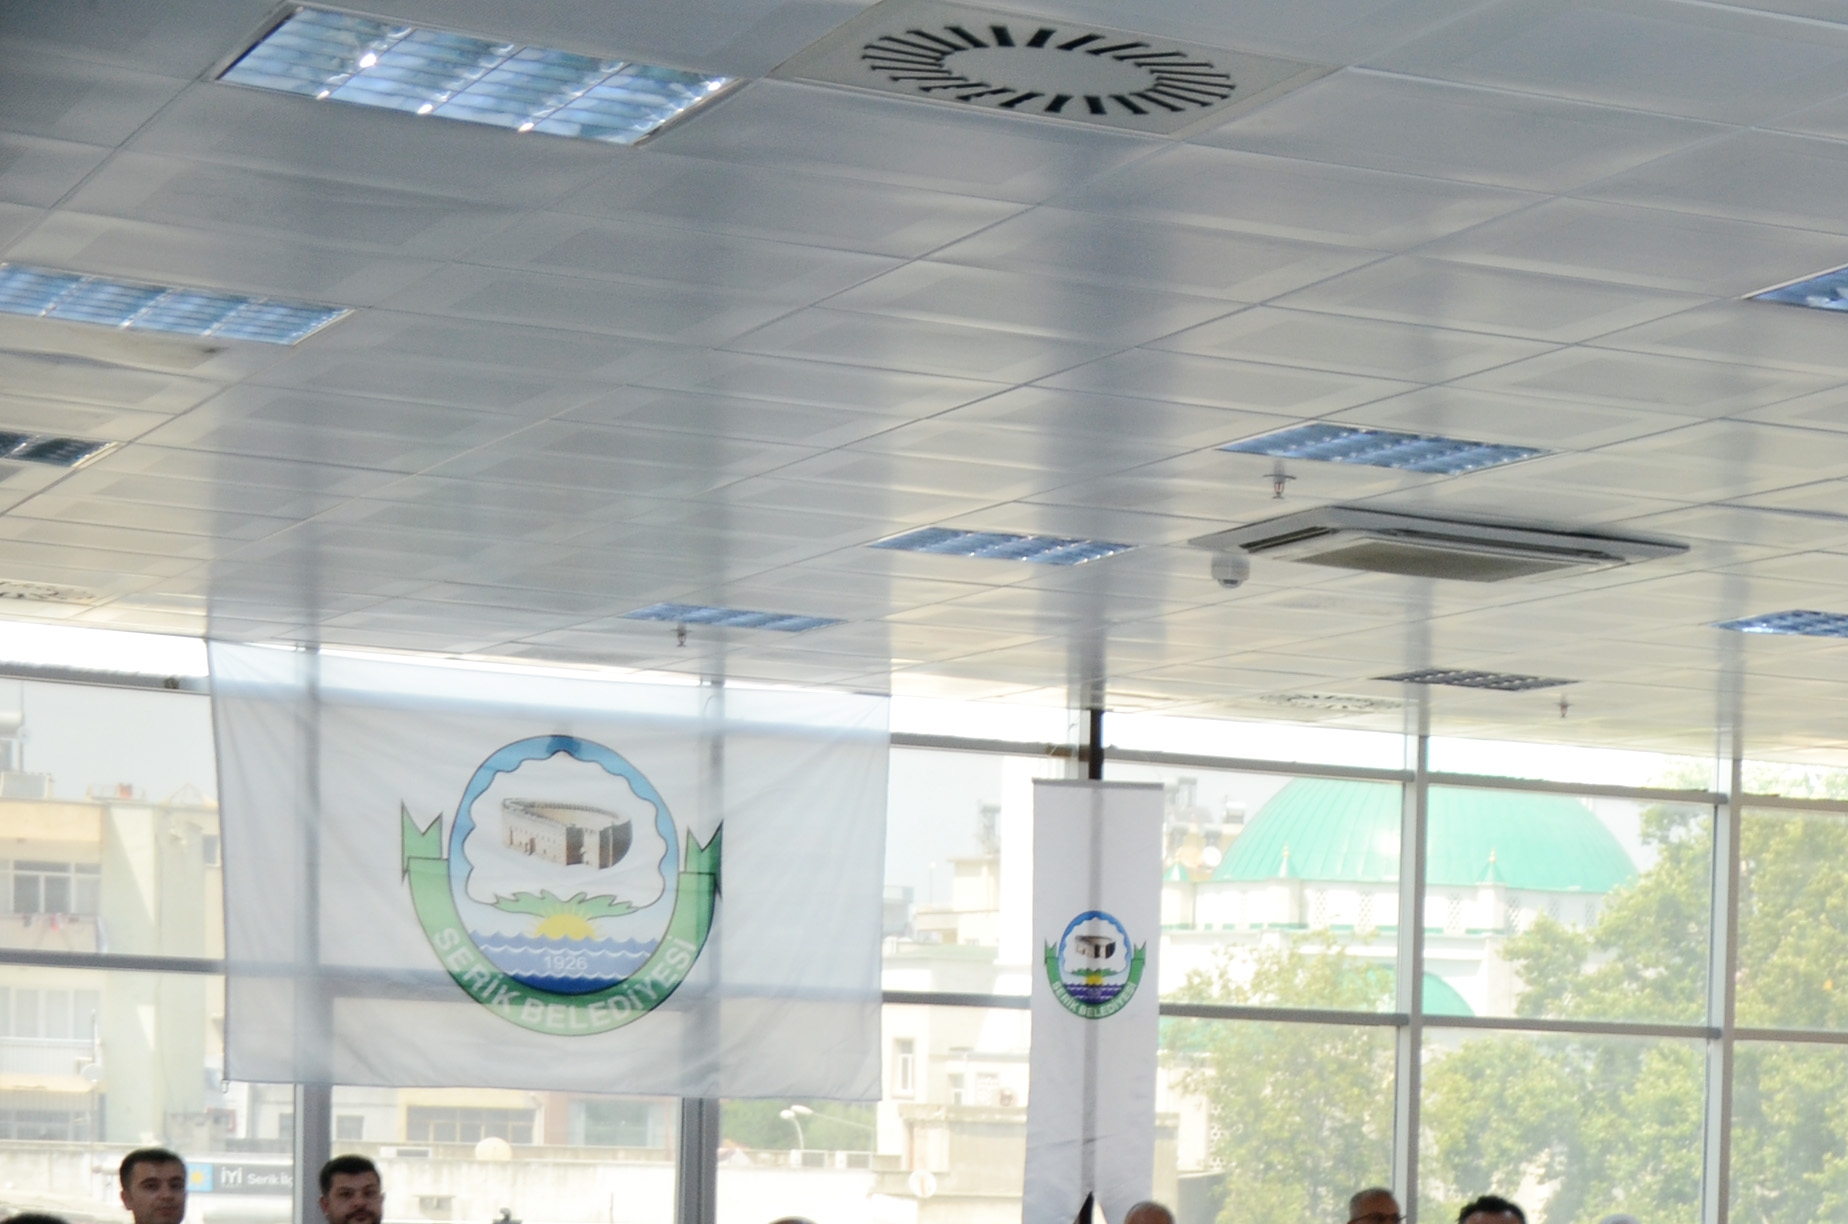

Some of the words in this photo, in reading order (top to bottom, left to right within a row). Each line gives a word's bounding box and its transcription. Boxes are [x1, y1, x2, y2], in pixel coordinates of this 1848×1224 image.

[544, 955, 588, 972] 1926
[434, 928, 520, 1013] SERİK
[521, 935, 698, 1029] BELEDİYESİ
[221, 1166, 243, 1184] İYİ
[247, 1173, 279, 1185] Serik
